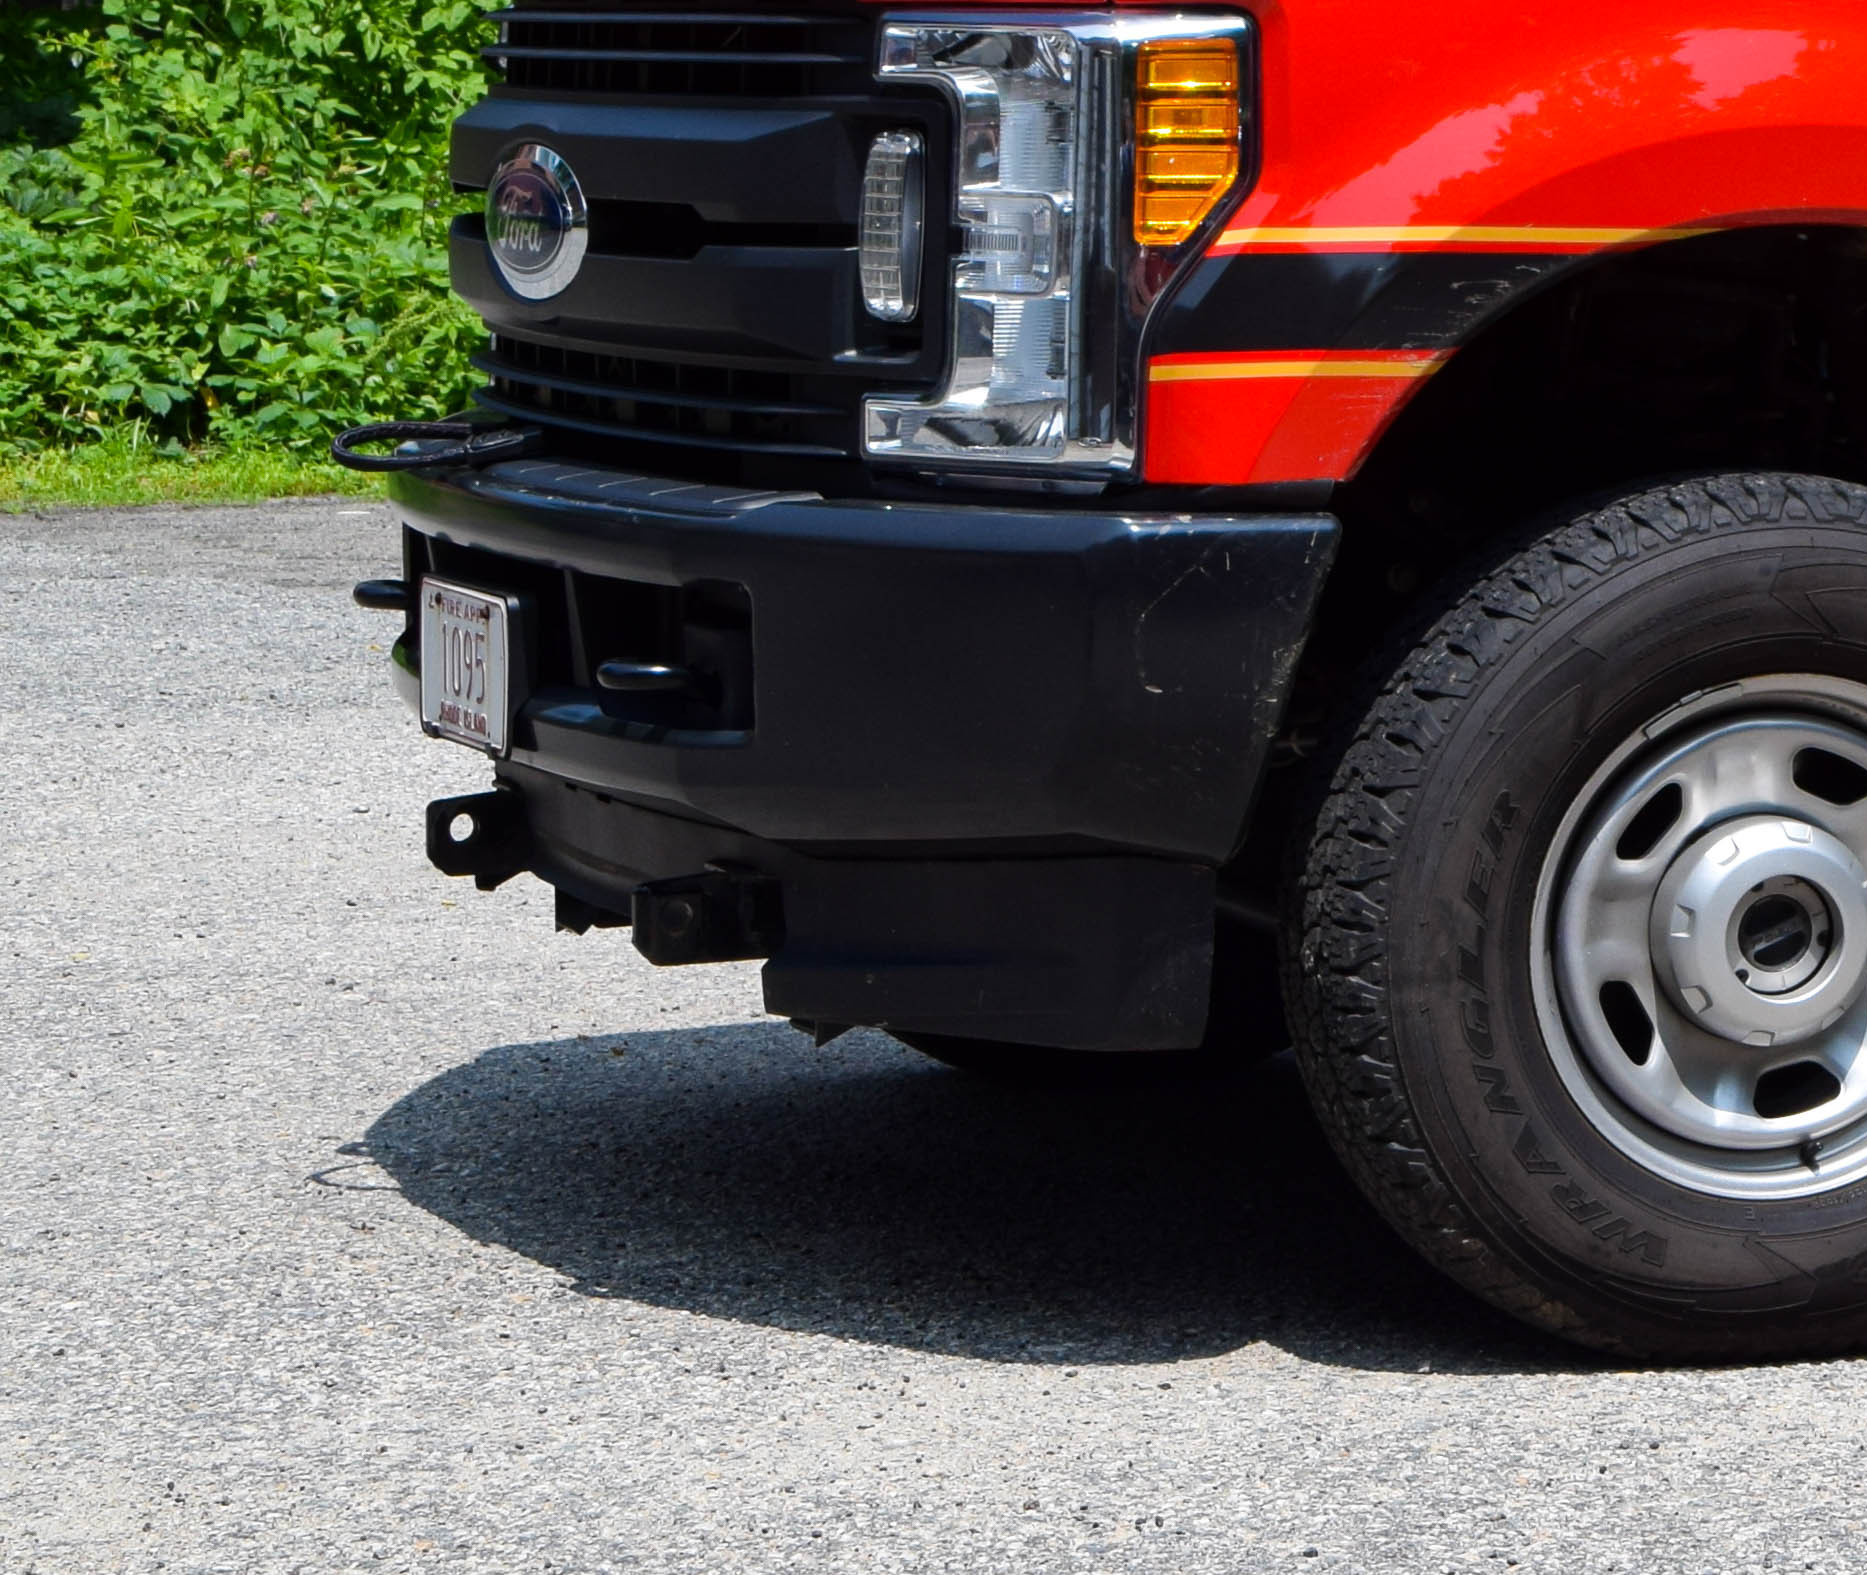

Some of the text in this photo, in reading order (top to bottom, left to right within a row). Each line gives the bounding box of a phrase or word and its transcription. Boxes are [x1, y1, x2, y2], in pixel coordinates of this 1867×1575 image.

[497, 185, 543, 252] Ford
[441, 596, 462, 620] FIRE
[442, 621, 487, 705] 1095
[1450, 787, 1669, 1268] WRANGLER
